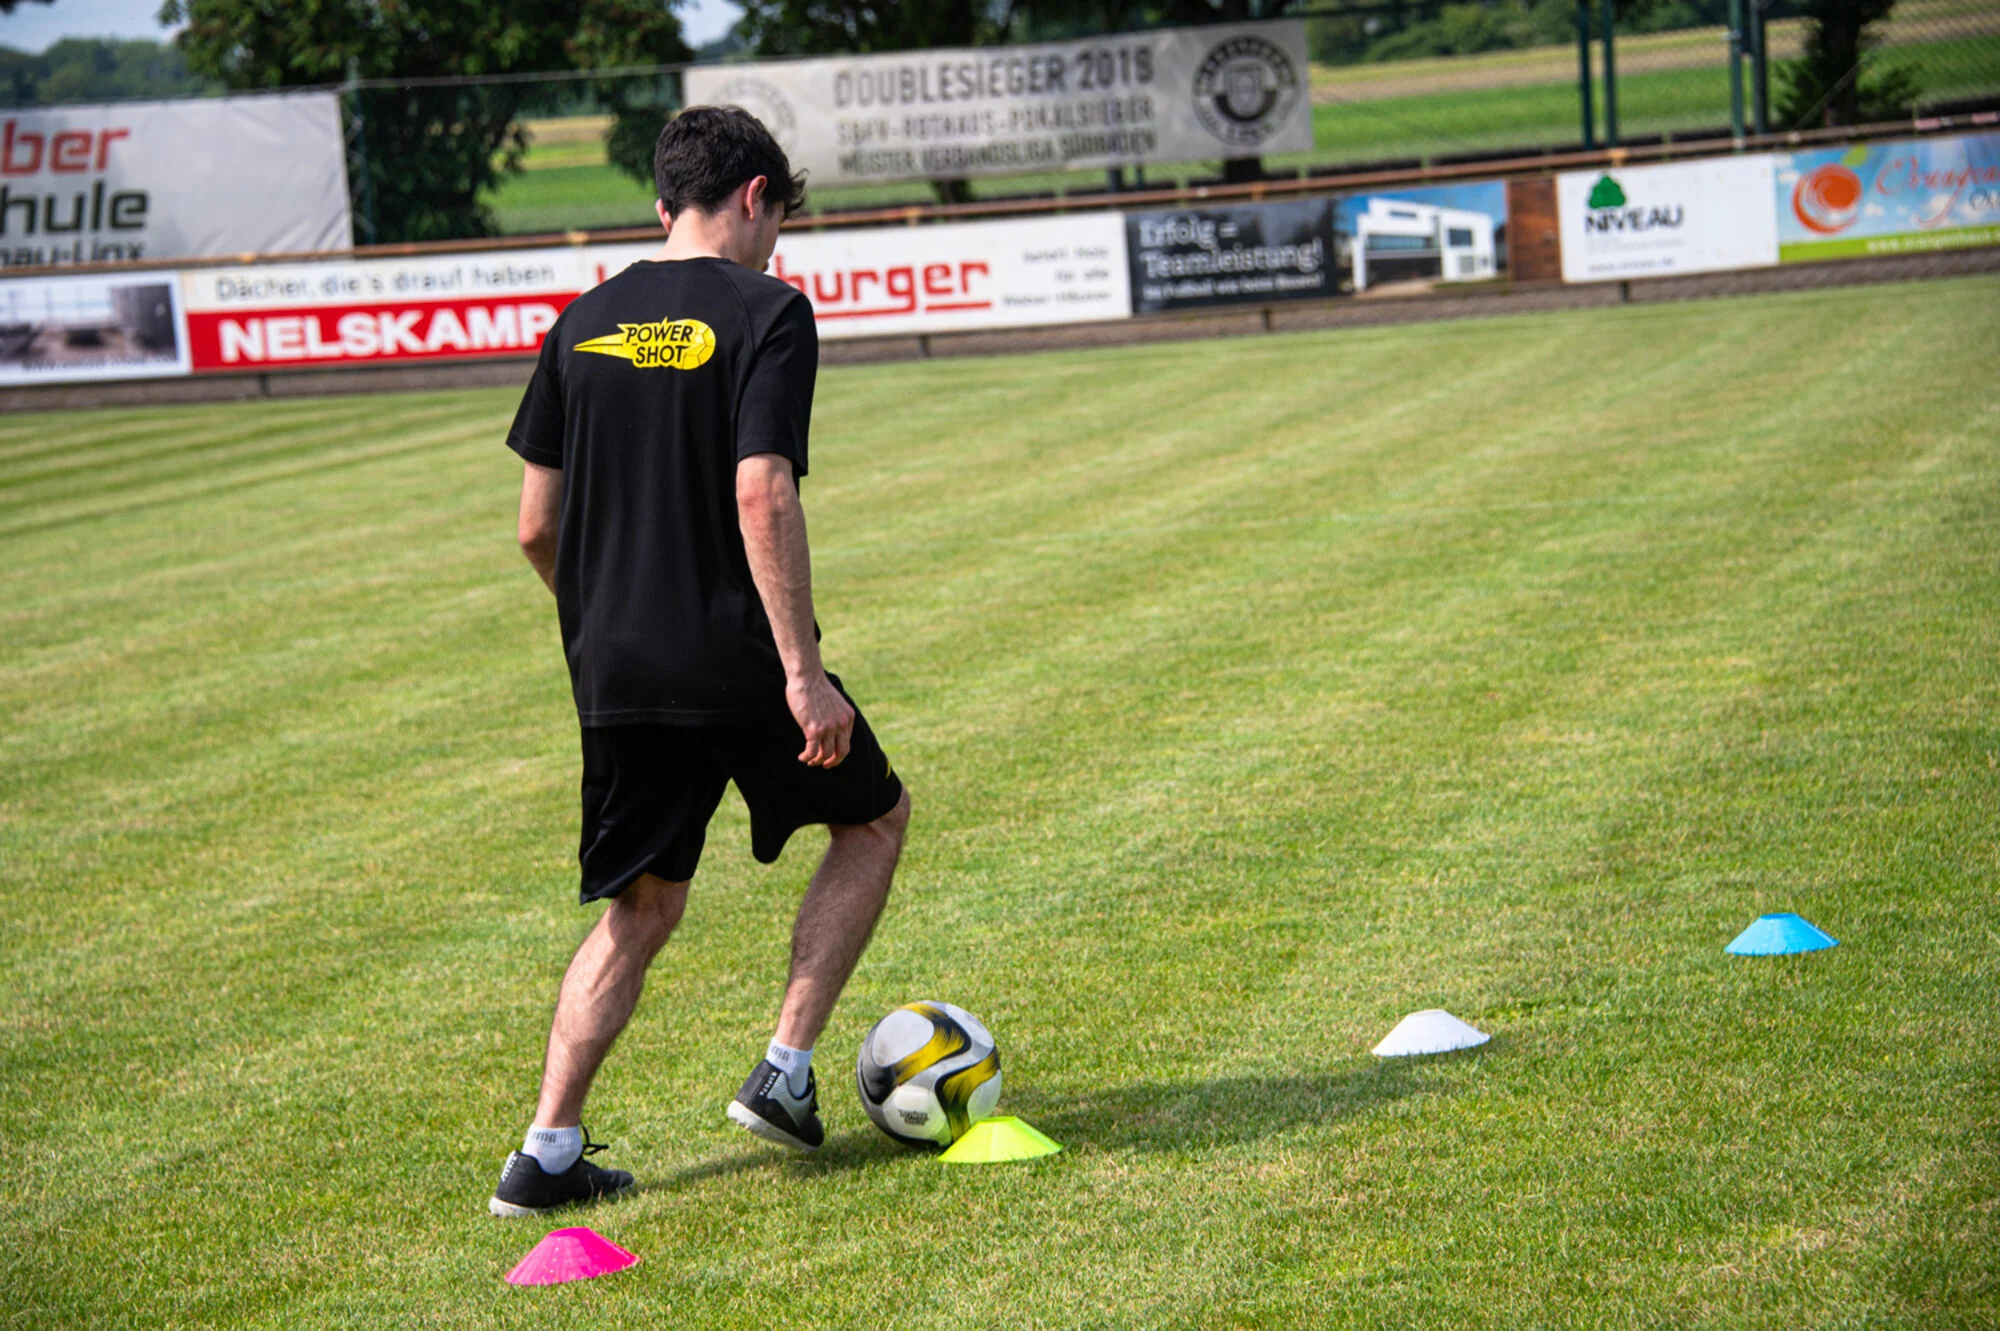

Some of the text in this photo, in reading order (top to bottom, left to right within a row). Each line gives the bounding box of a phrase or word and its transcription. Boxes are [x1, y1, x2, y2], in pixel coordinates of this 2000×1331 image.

[836, 54, 1067, 107] DOUBLESIEGER
[1138, 214, 1218, 250] Erfolg
[1584, 203, 1685, 236] NIVEAU
[1140, 237, 1323, 278] Teamleistung!
[391, 264, 463, 292] drauf
[470, 262, 555, 287] haben
[218, 302, 559, 364] NELSKAMP
[626, 325, 693, 345] POWER
[636, 345, 688, 363] SHOT
